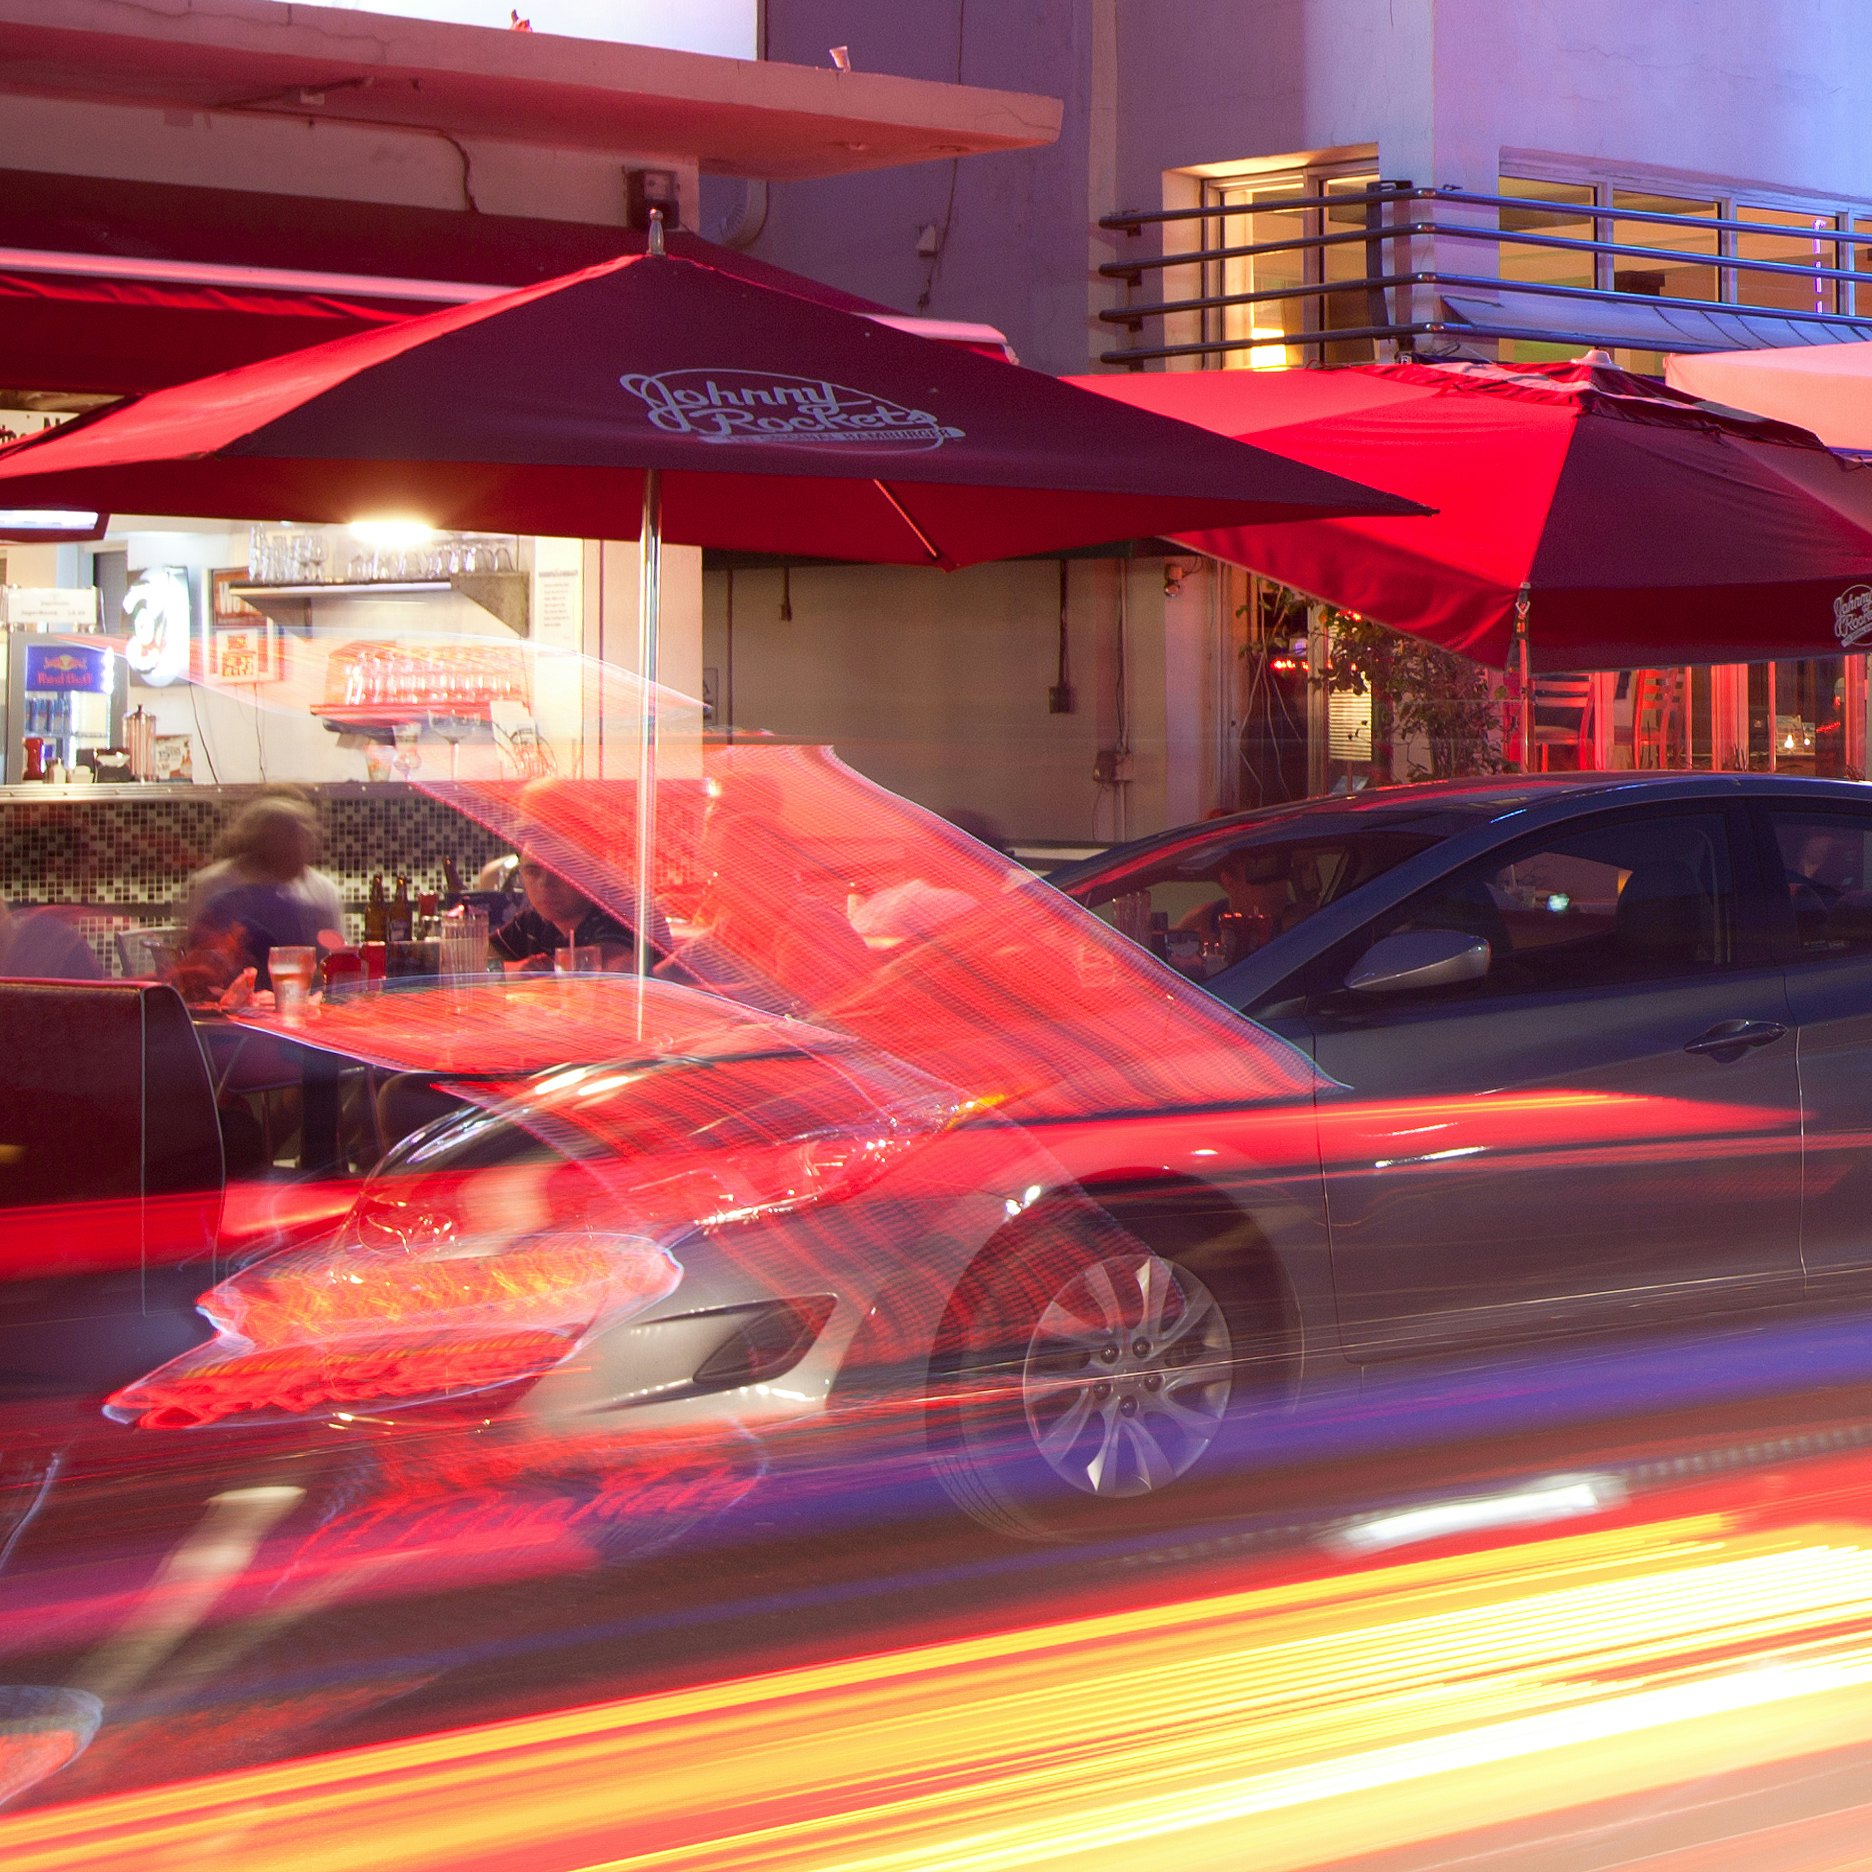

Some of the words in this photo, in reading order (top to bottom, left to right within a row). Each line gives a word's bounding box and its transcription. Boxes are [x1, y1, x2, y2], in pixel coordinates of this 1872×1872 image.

[619, 372, 873, 433] Johnny
[688, 405, 939, 436] Rockets
[844, 427, 950, 442] HAMBURGER
